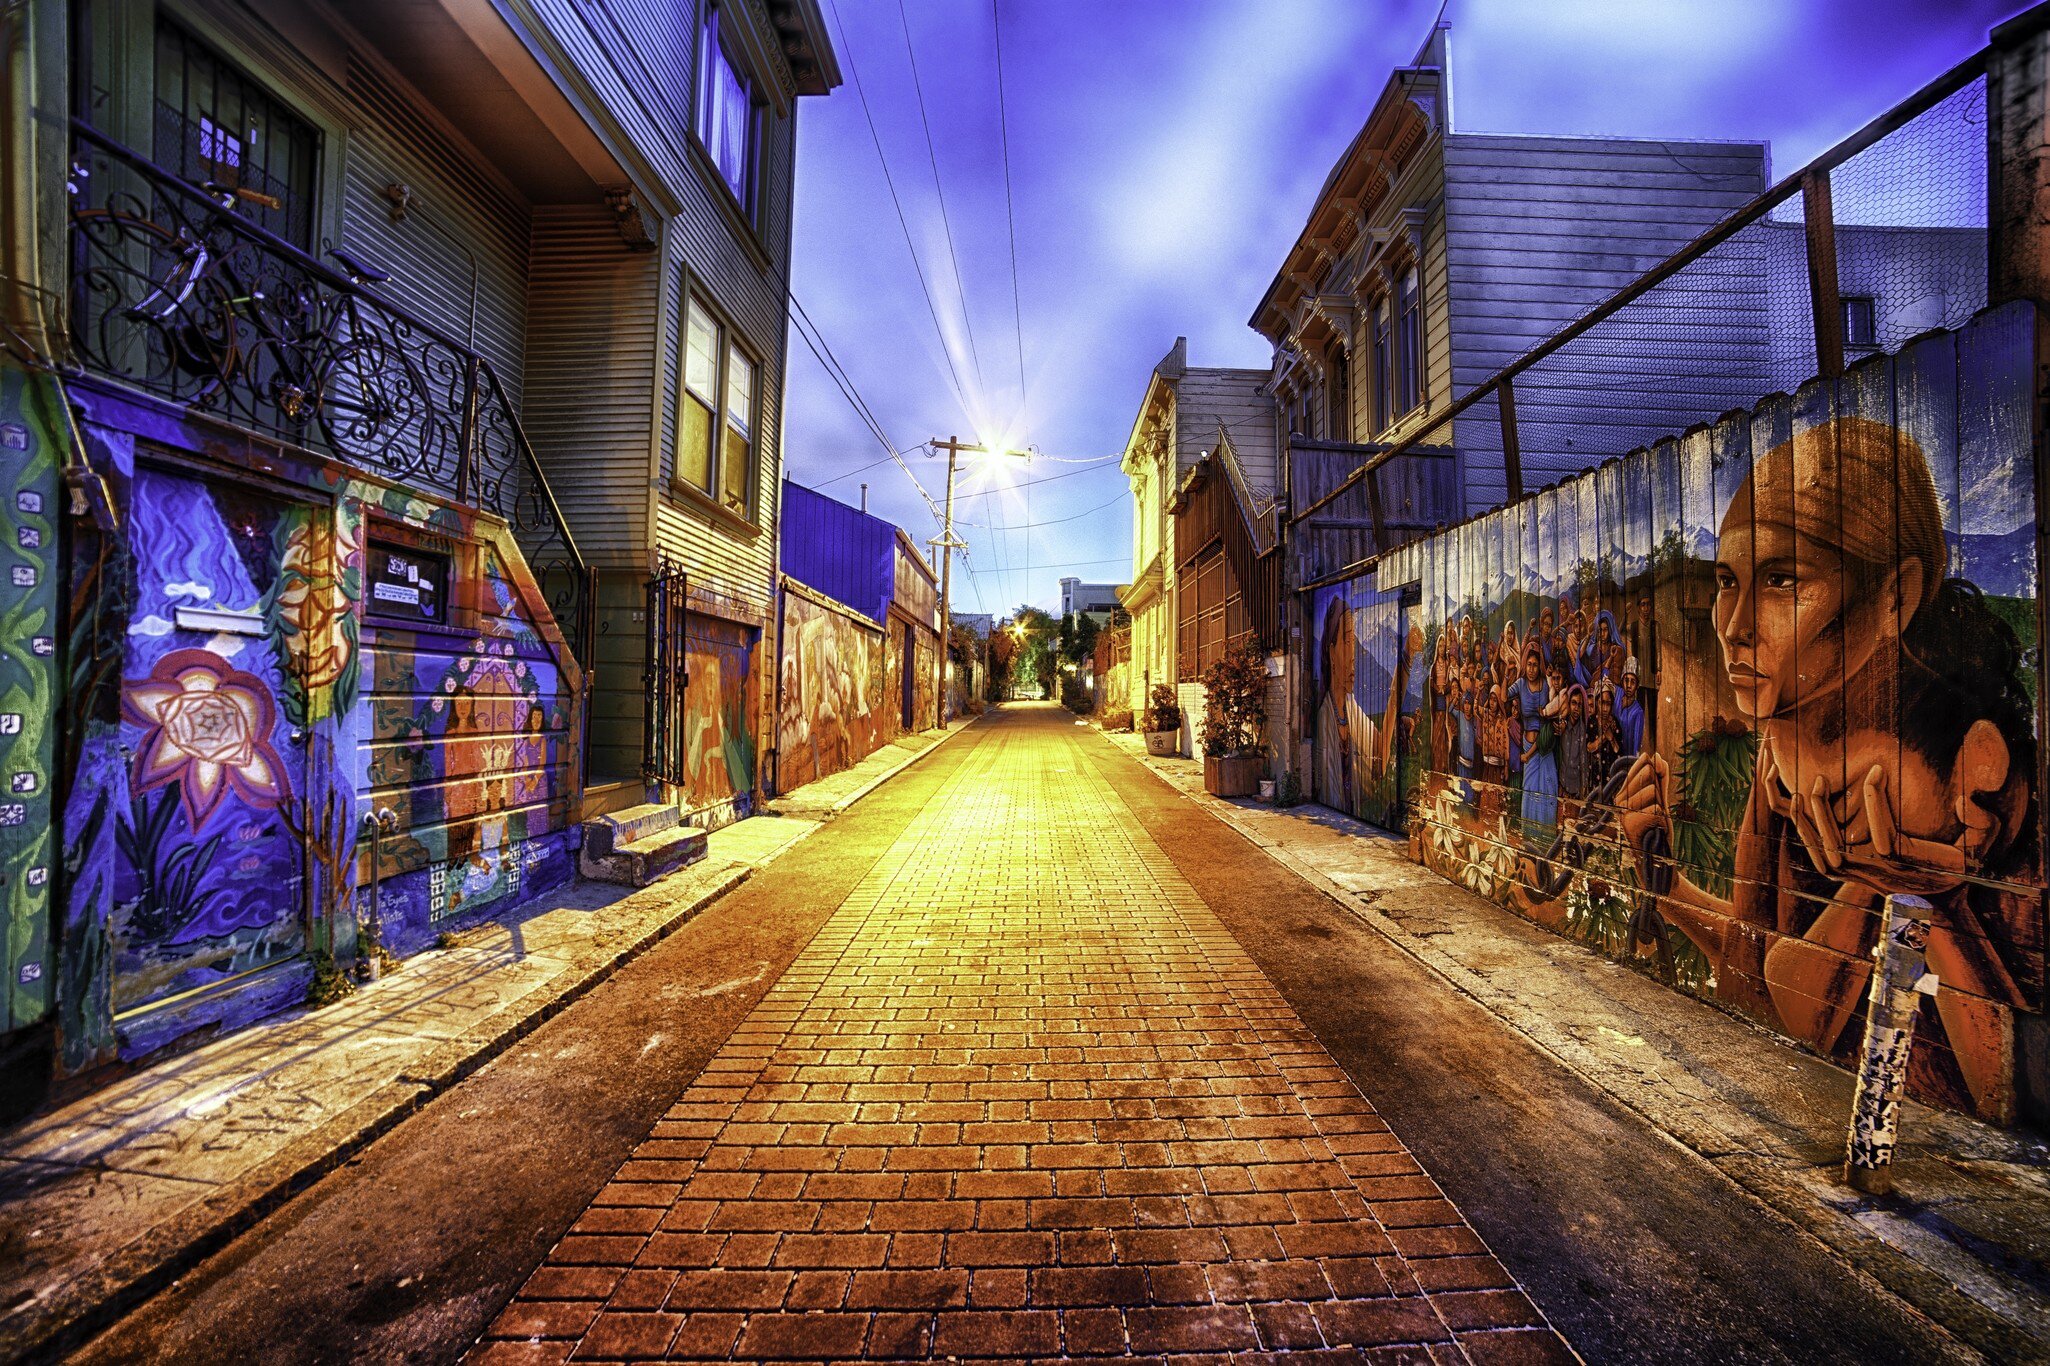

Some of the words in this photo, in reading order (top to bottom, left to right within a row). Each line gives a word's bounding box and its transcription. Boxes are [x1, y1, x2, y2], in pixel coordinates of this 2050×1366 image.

[92, 84, 112, 109] 7
[601, 621, 609, 635] 9
[387, 893, 409, 909] Eyes
